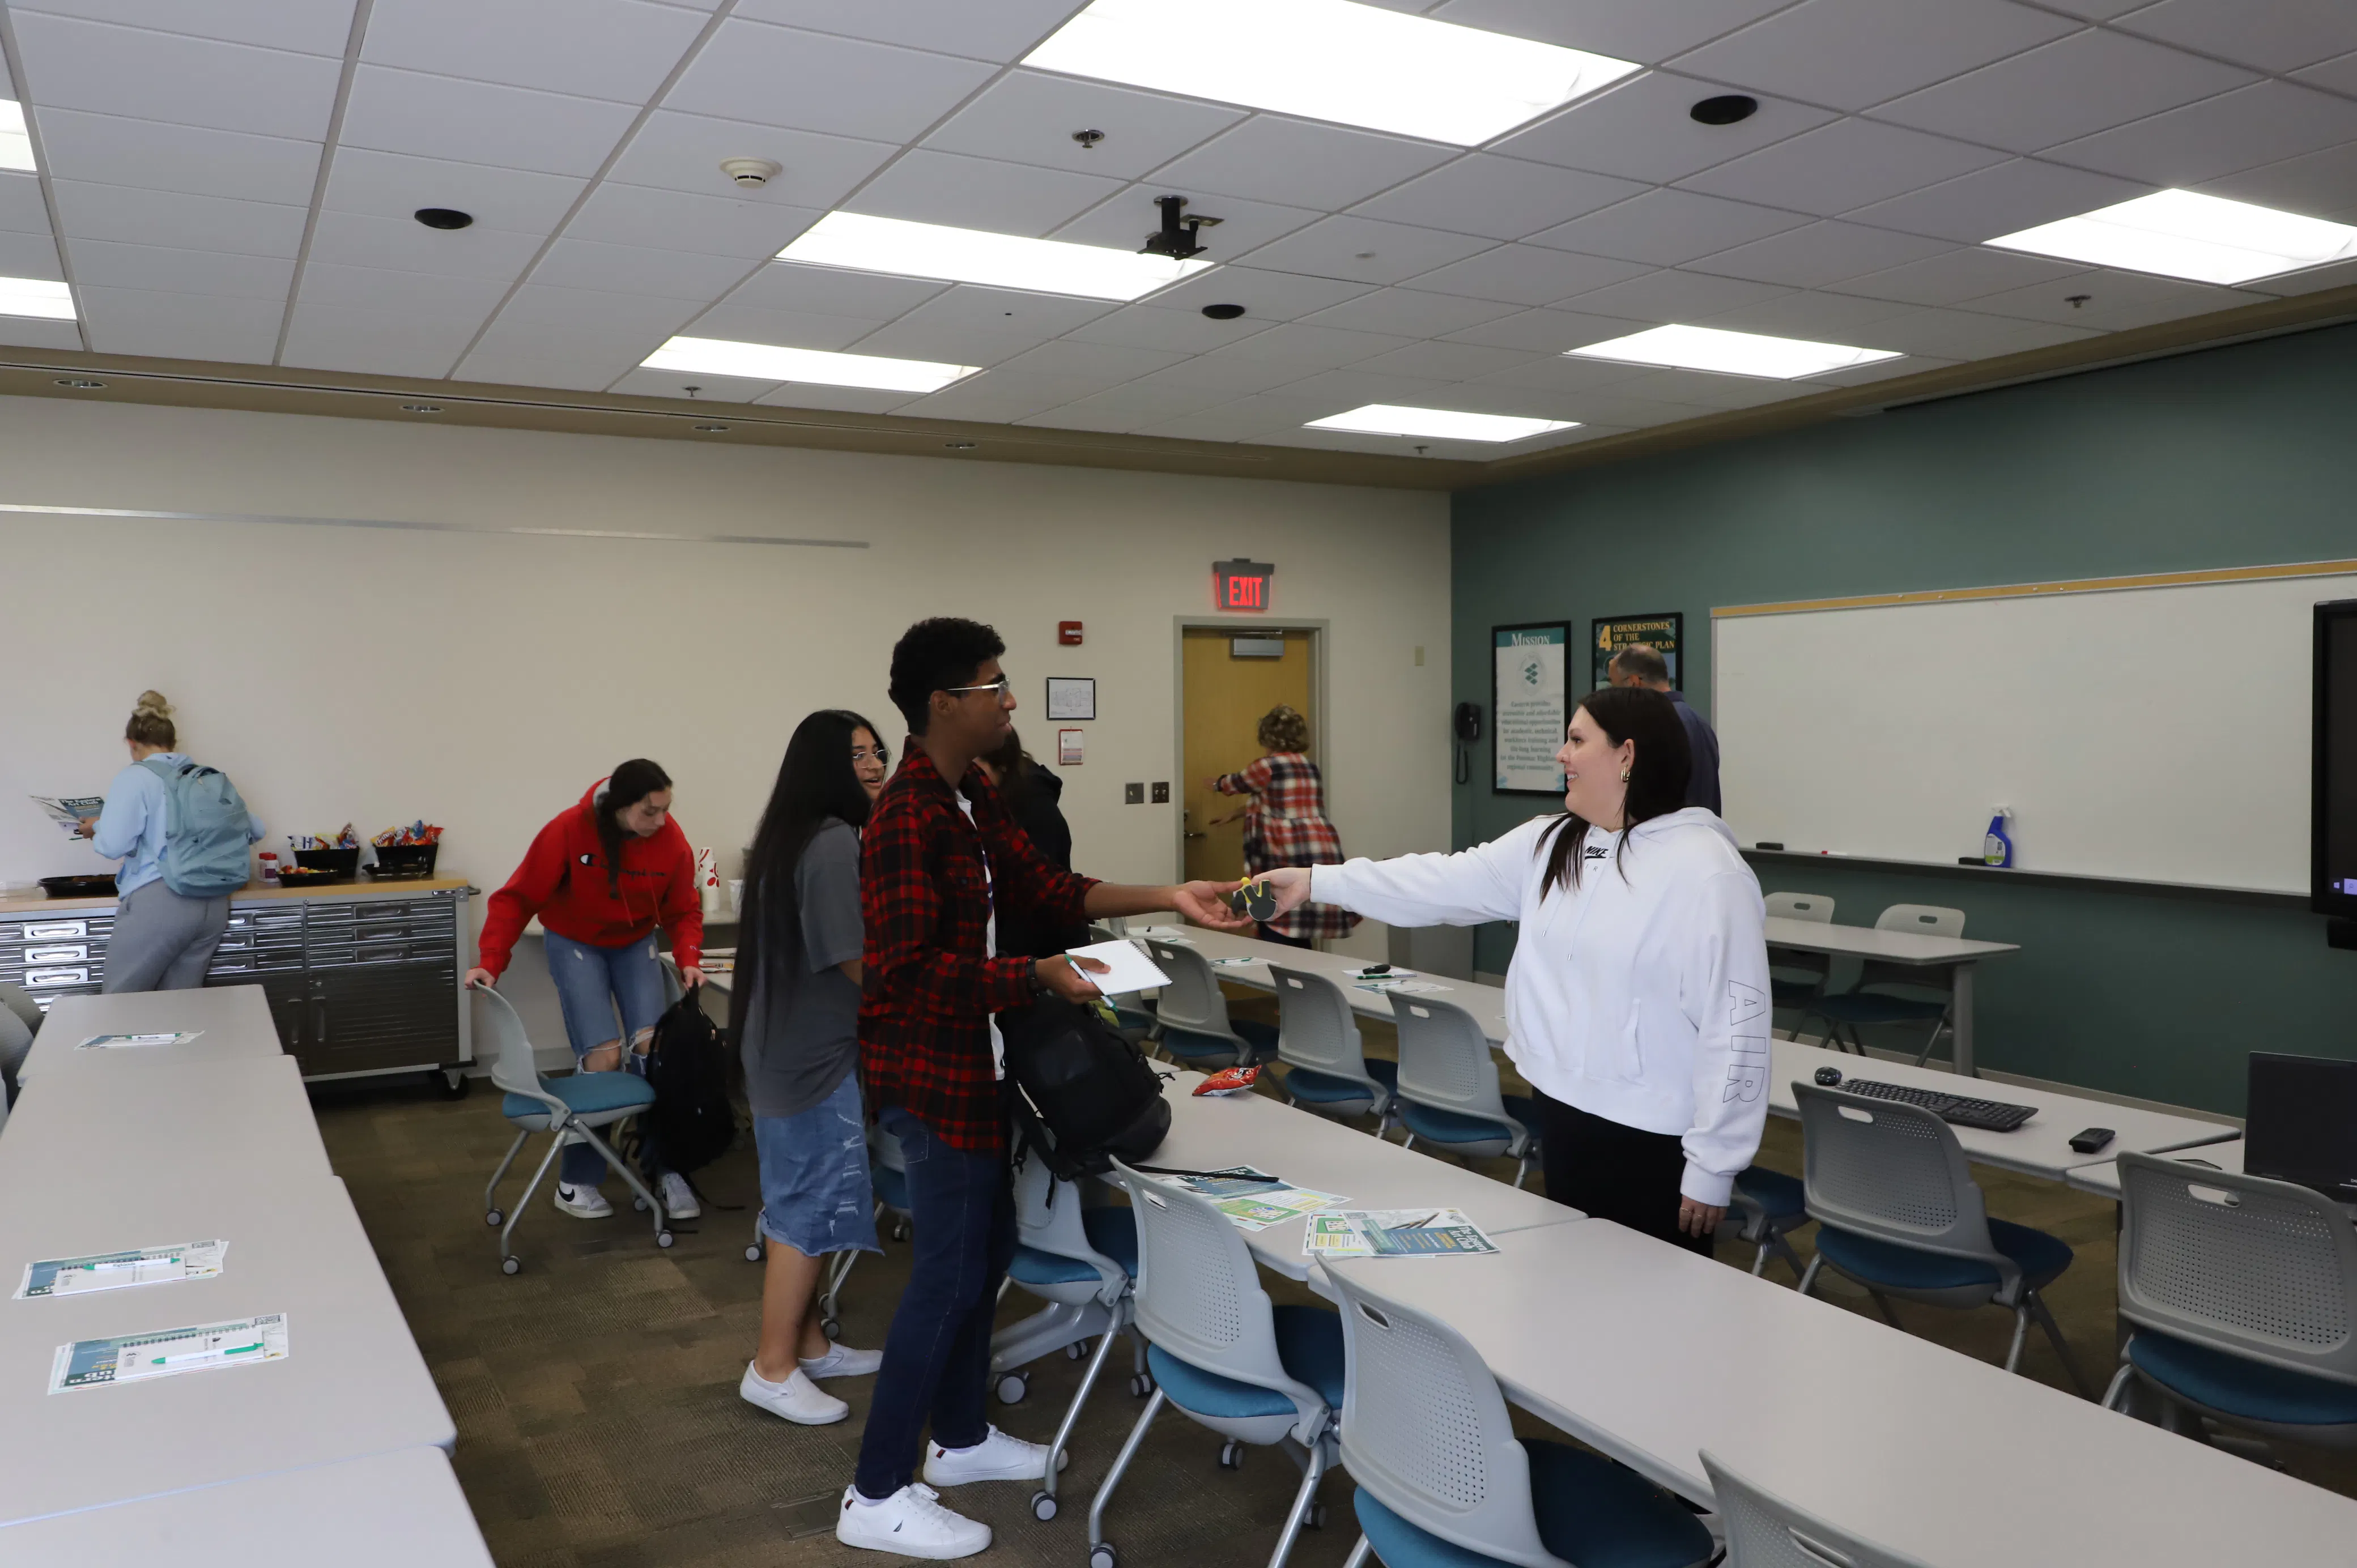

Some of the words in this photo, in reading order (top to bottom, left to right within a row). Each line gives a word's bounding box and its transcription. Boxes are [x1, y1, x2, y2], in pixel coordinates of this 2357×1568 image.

[1229, 576, 1263, 606] EXIT
[1613, 621, 1670, 632] CORNERSTONES
[1599, 625, 1612, 651] 4
[1626, 633, 1640, 641] THE
[1655, 640, 1675, 649] PLAN
[1585, 846, 1609, 857] NIKE
[1724, 980, 1766, 1103] AIR
[1456, 1237, 1475, 1249] Club
